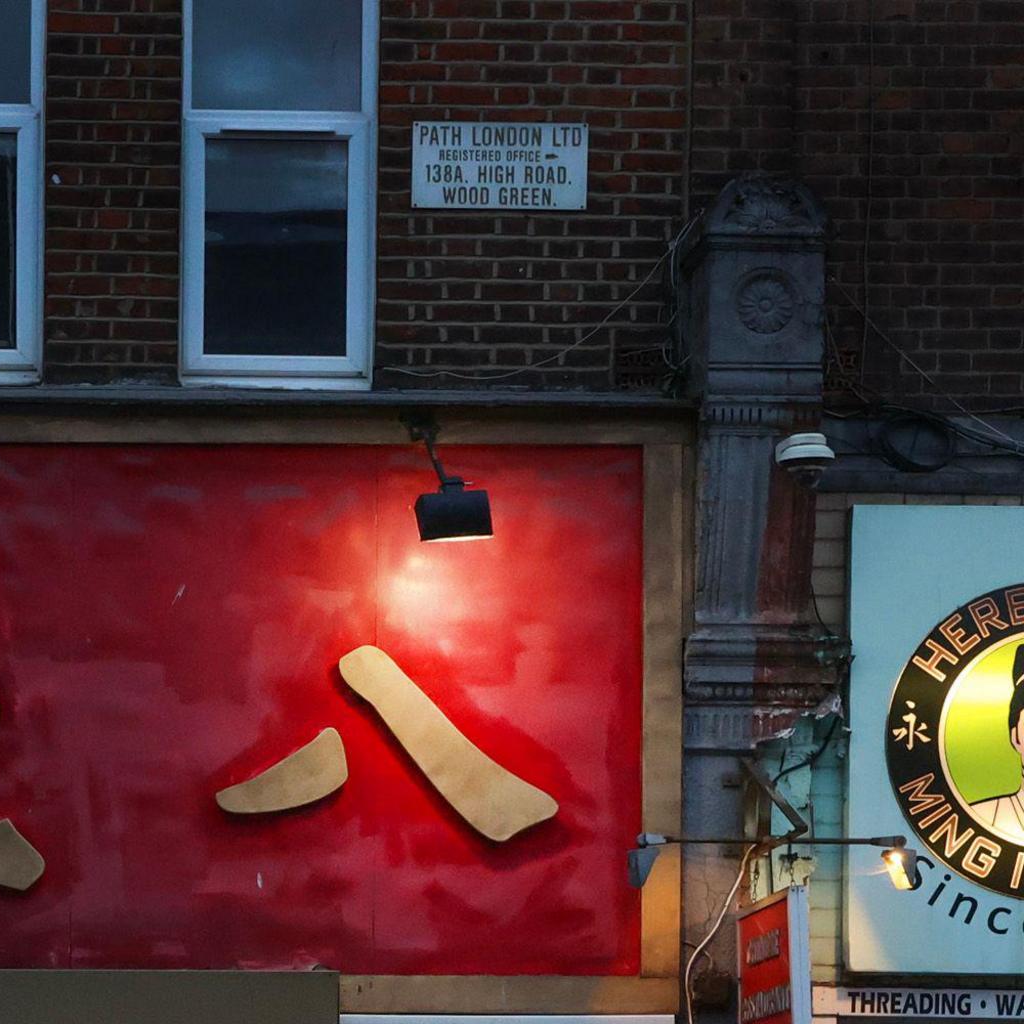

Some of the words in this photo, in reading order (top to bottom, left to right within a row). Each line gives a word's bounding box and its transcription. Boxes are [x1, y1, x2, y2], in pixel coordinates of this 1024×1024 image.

[419, 125, 461, 147] PATH
[472, 126, 542, 147] LONDON
[552, 127, 582, 147] LTD
[438, 149, 501, 162] REGISTERED
[506, 150, 541, 162] OFFICE
[477, 165, 514, 184] HIGH
[443, 187, 489, 205] WOOD
[891, 700, 931, 751] 永
[899, 772, 1002, 881] MING
[907, 855, 1024, 935] Sinc
[848, 991, 971, 1015] THREADING
